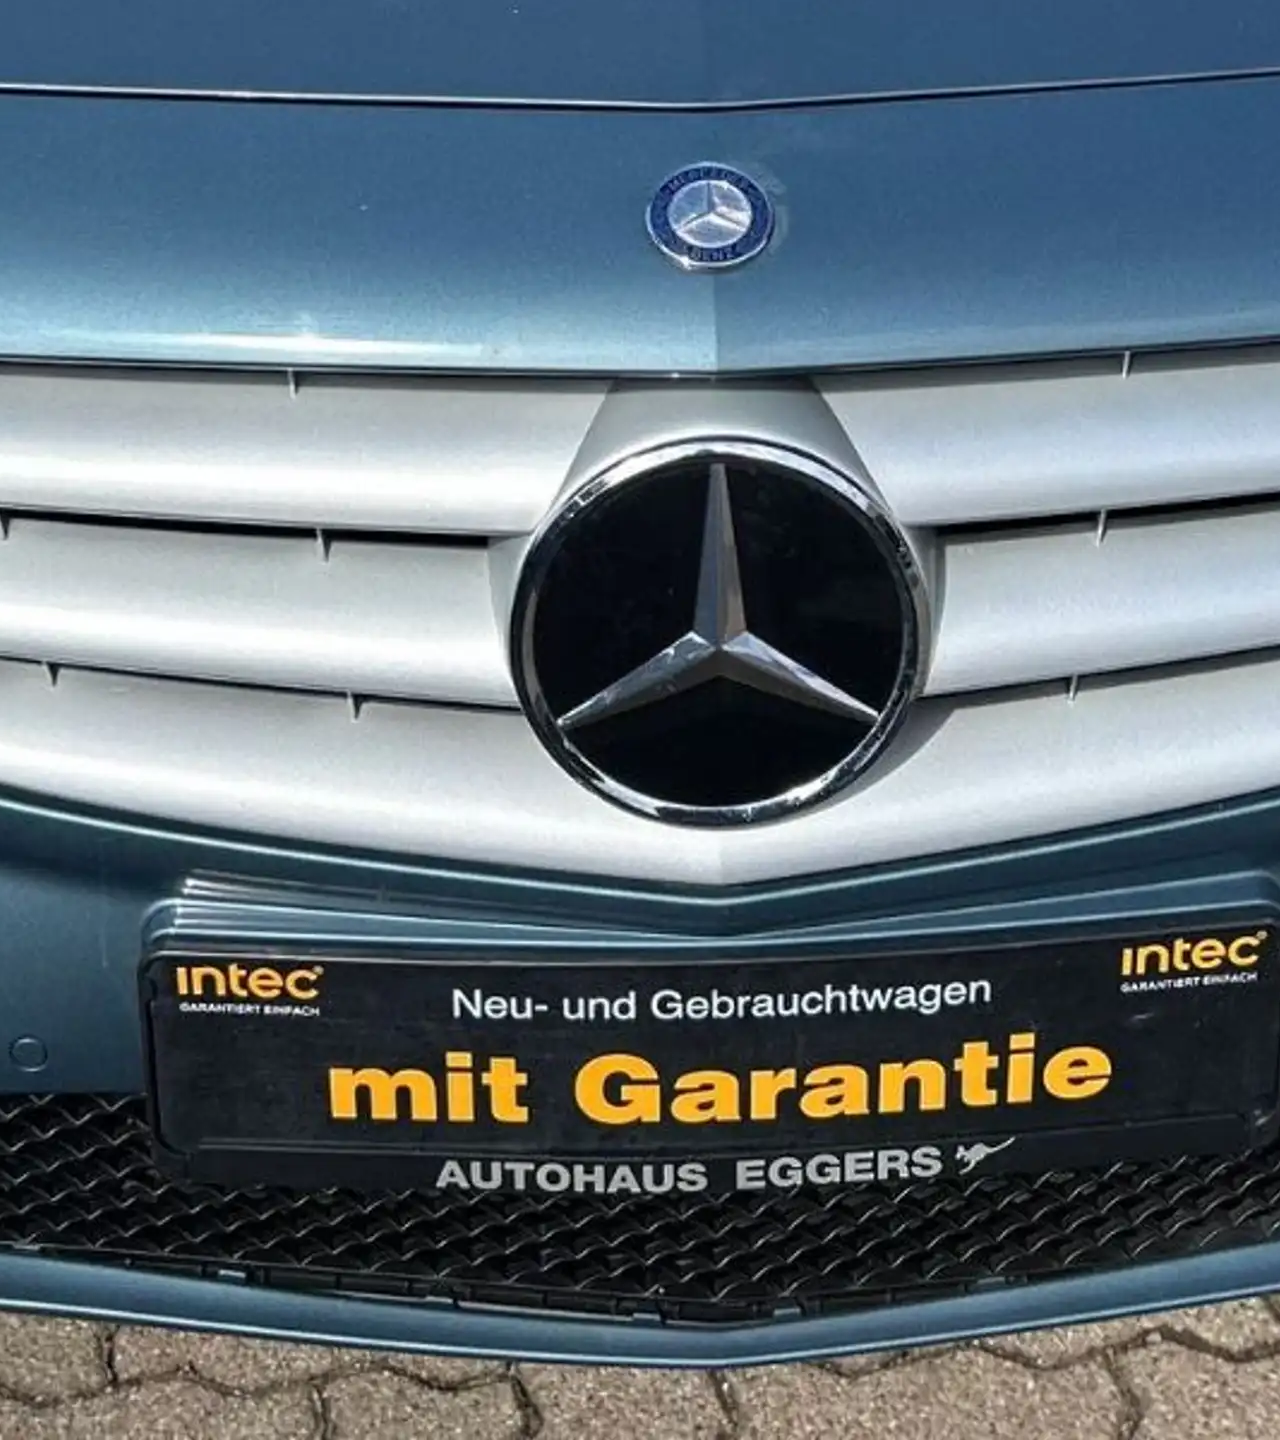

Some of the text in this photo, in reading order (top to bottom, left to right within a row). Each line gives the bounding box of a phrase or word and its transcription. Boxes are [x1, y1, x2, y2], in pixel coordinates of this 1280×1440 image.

[452, 979, 992, 1020] Neu- und Gebrauchtwagen
[1120, 974, 1200, 993] GARANTIERT
[179, 1002, 260, 1015] GARANTIERT
[329, 1032, 1112, 1124] mit Garantie
[435, 1146, 943, 1194] AUTOHAUS EGGERS
